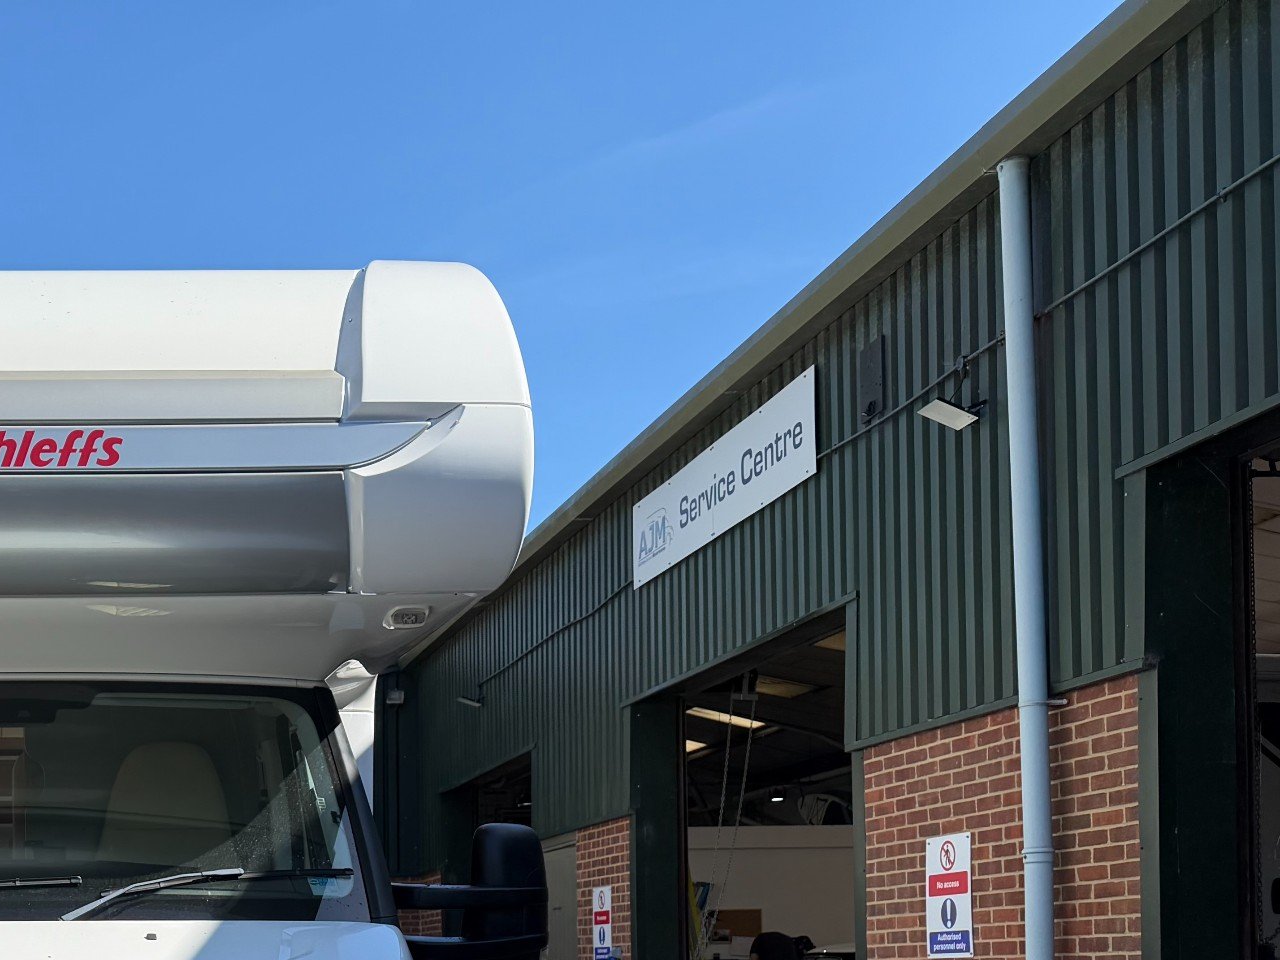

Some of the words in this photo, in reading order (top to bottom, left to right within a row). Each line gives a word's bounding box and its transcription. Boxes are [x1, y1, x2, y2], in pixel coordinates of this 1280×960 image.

[679, 470, 736, 529] Service
[740, 421, 803, 486] Centre
[638, 515, 666, 560] AJM
[936, 881, 944, 889] No
[944, 880, 960, 889] access
[937, 932, 962, 941] Authorised
[933, 941, 956, 952] personnel
[956, 941, 967, 951] only
